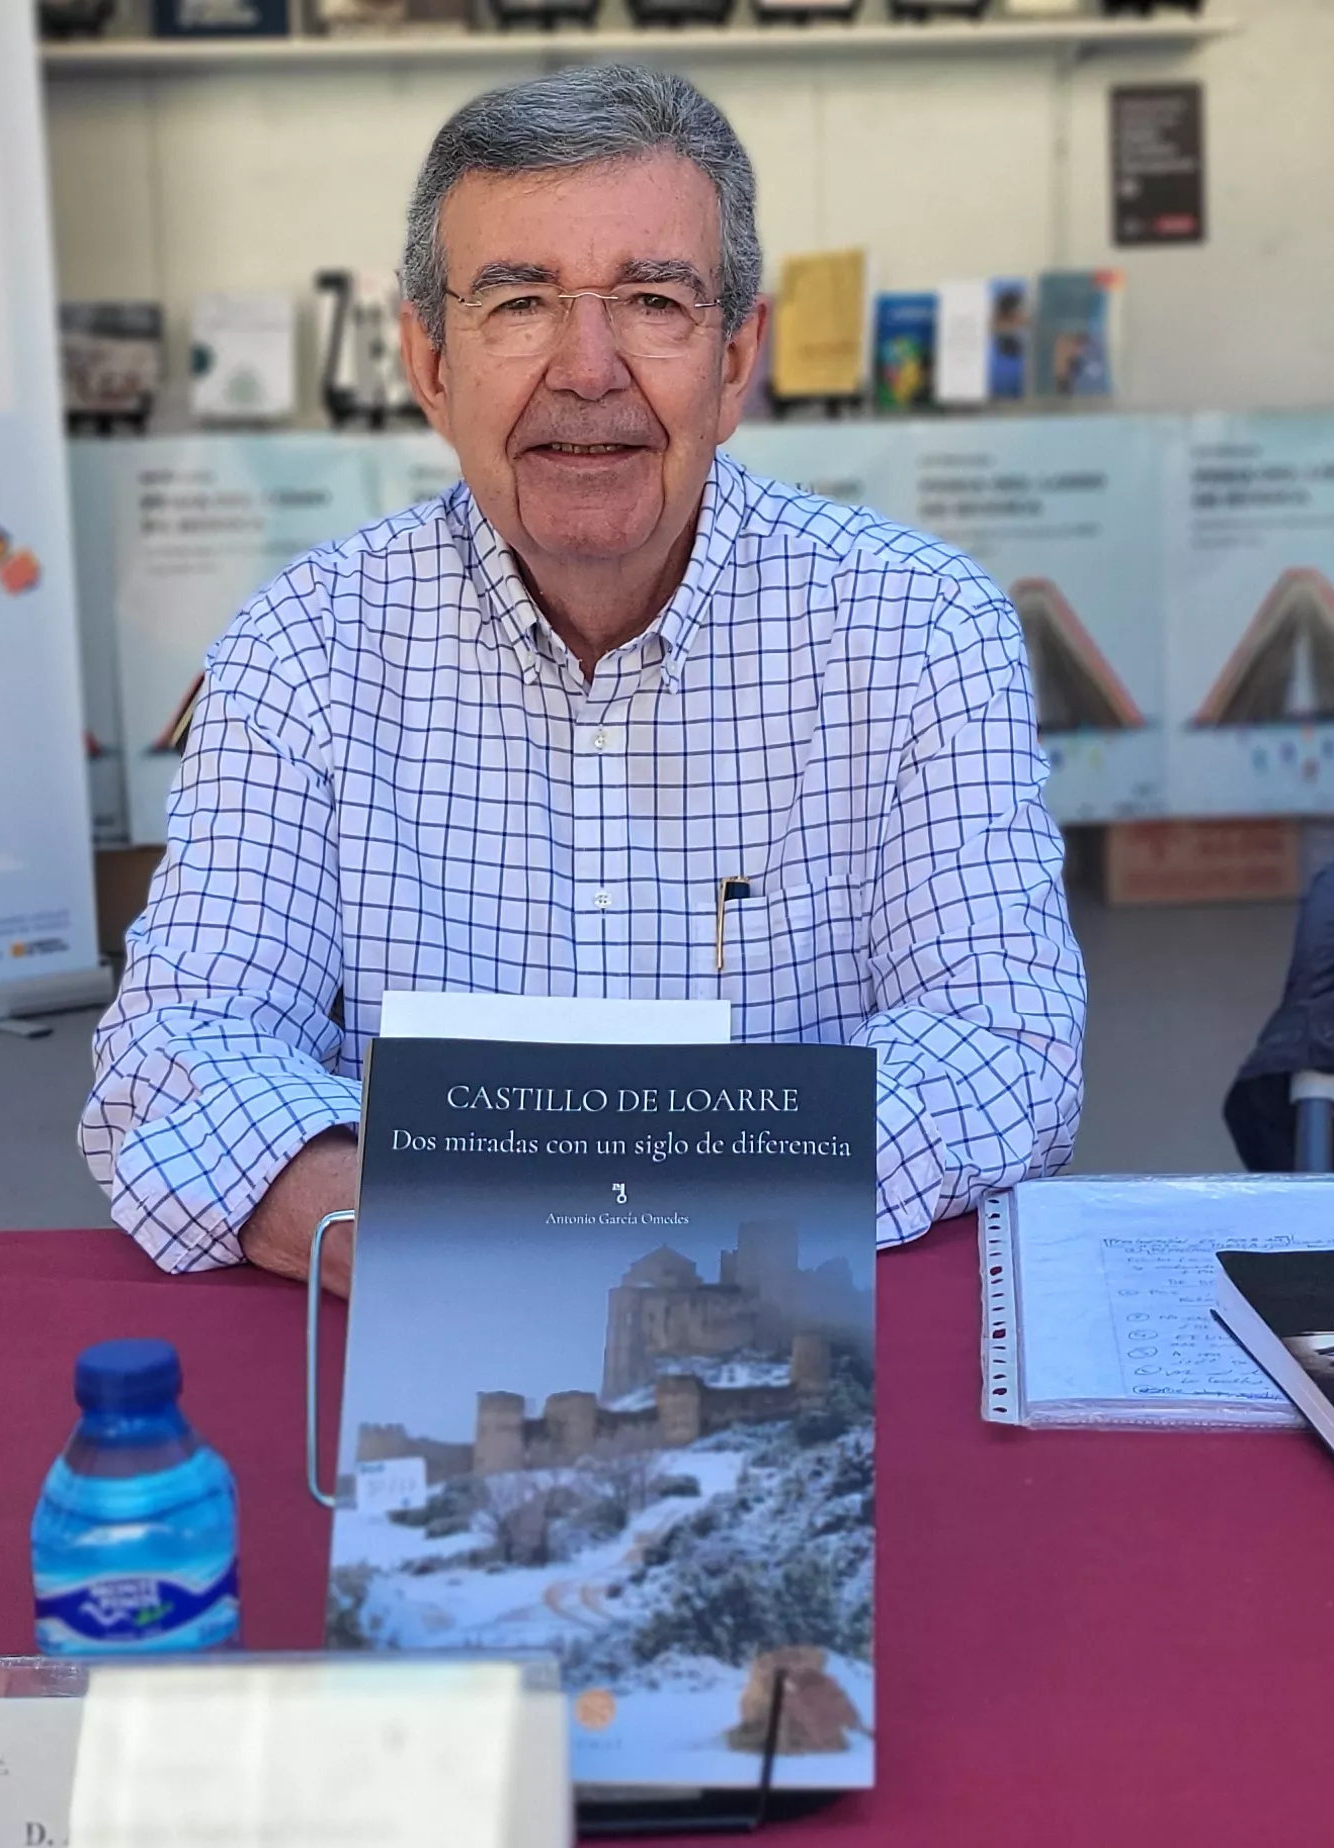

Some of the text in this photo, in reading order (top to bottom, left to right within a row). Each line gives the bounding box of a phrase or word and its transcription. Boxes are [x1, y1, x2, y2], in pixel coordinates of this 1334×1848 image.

[446, 1085, 799, 1113] CASTILLO DE LOARRE
[391, 1129, 852, 1163] Dos miradas con un siglo de diferencia
[545, 1211, 690, 1225] Antonio García Omedes
[25, 1821, 54, 1847] D.
